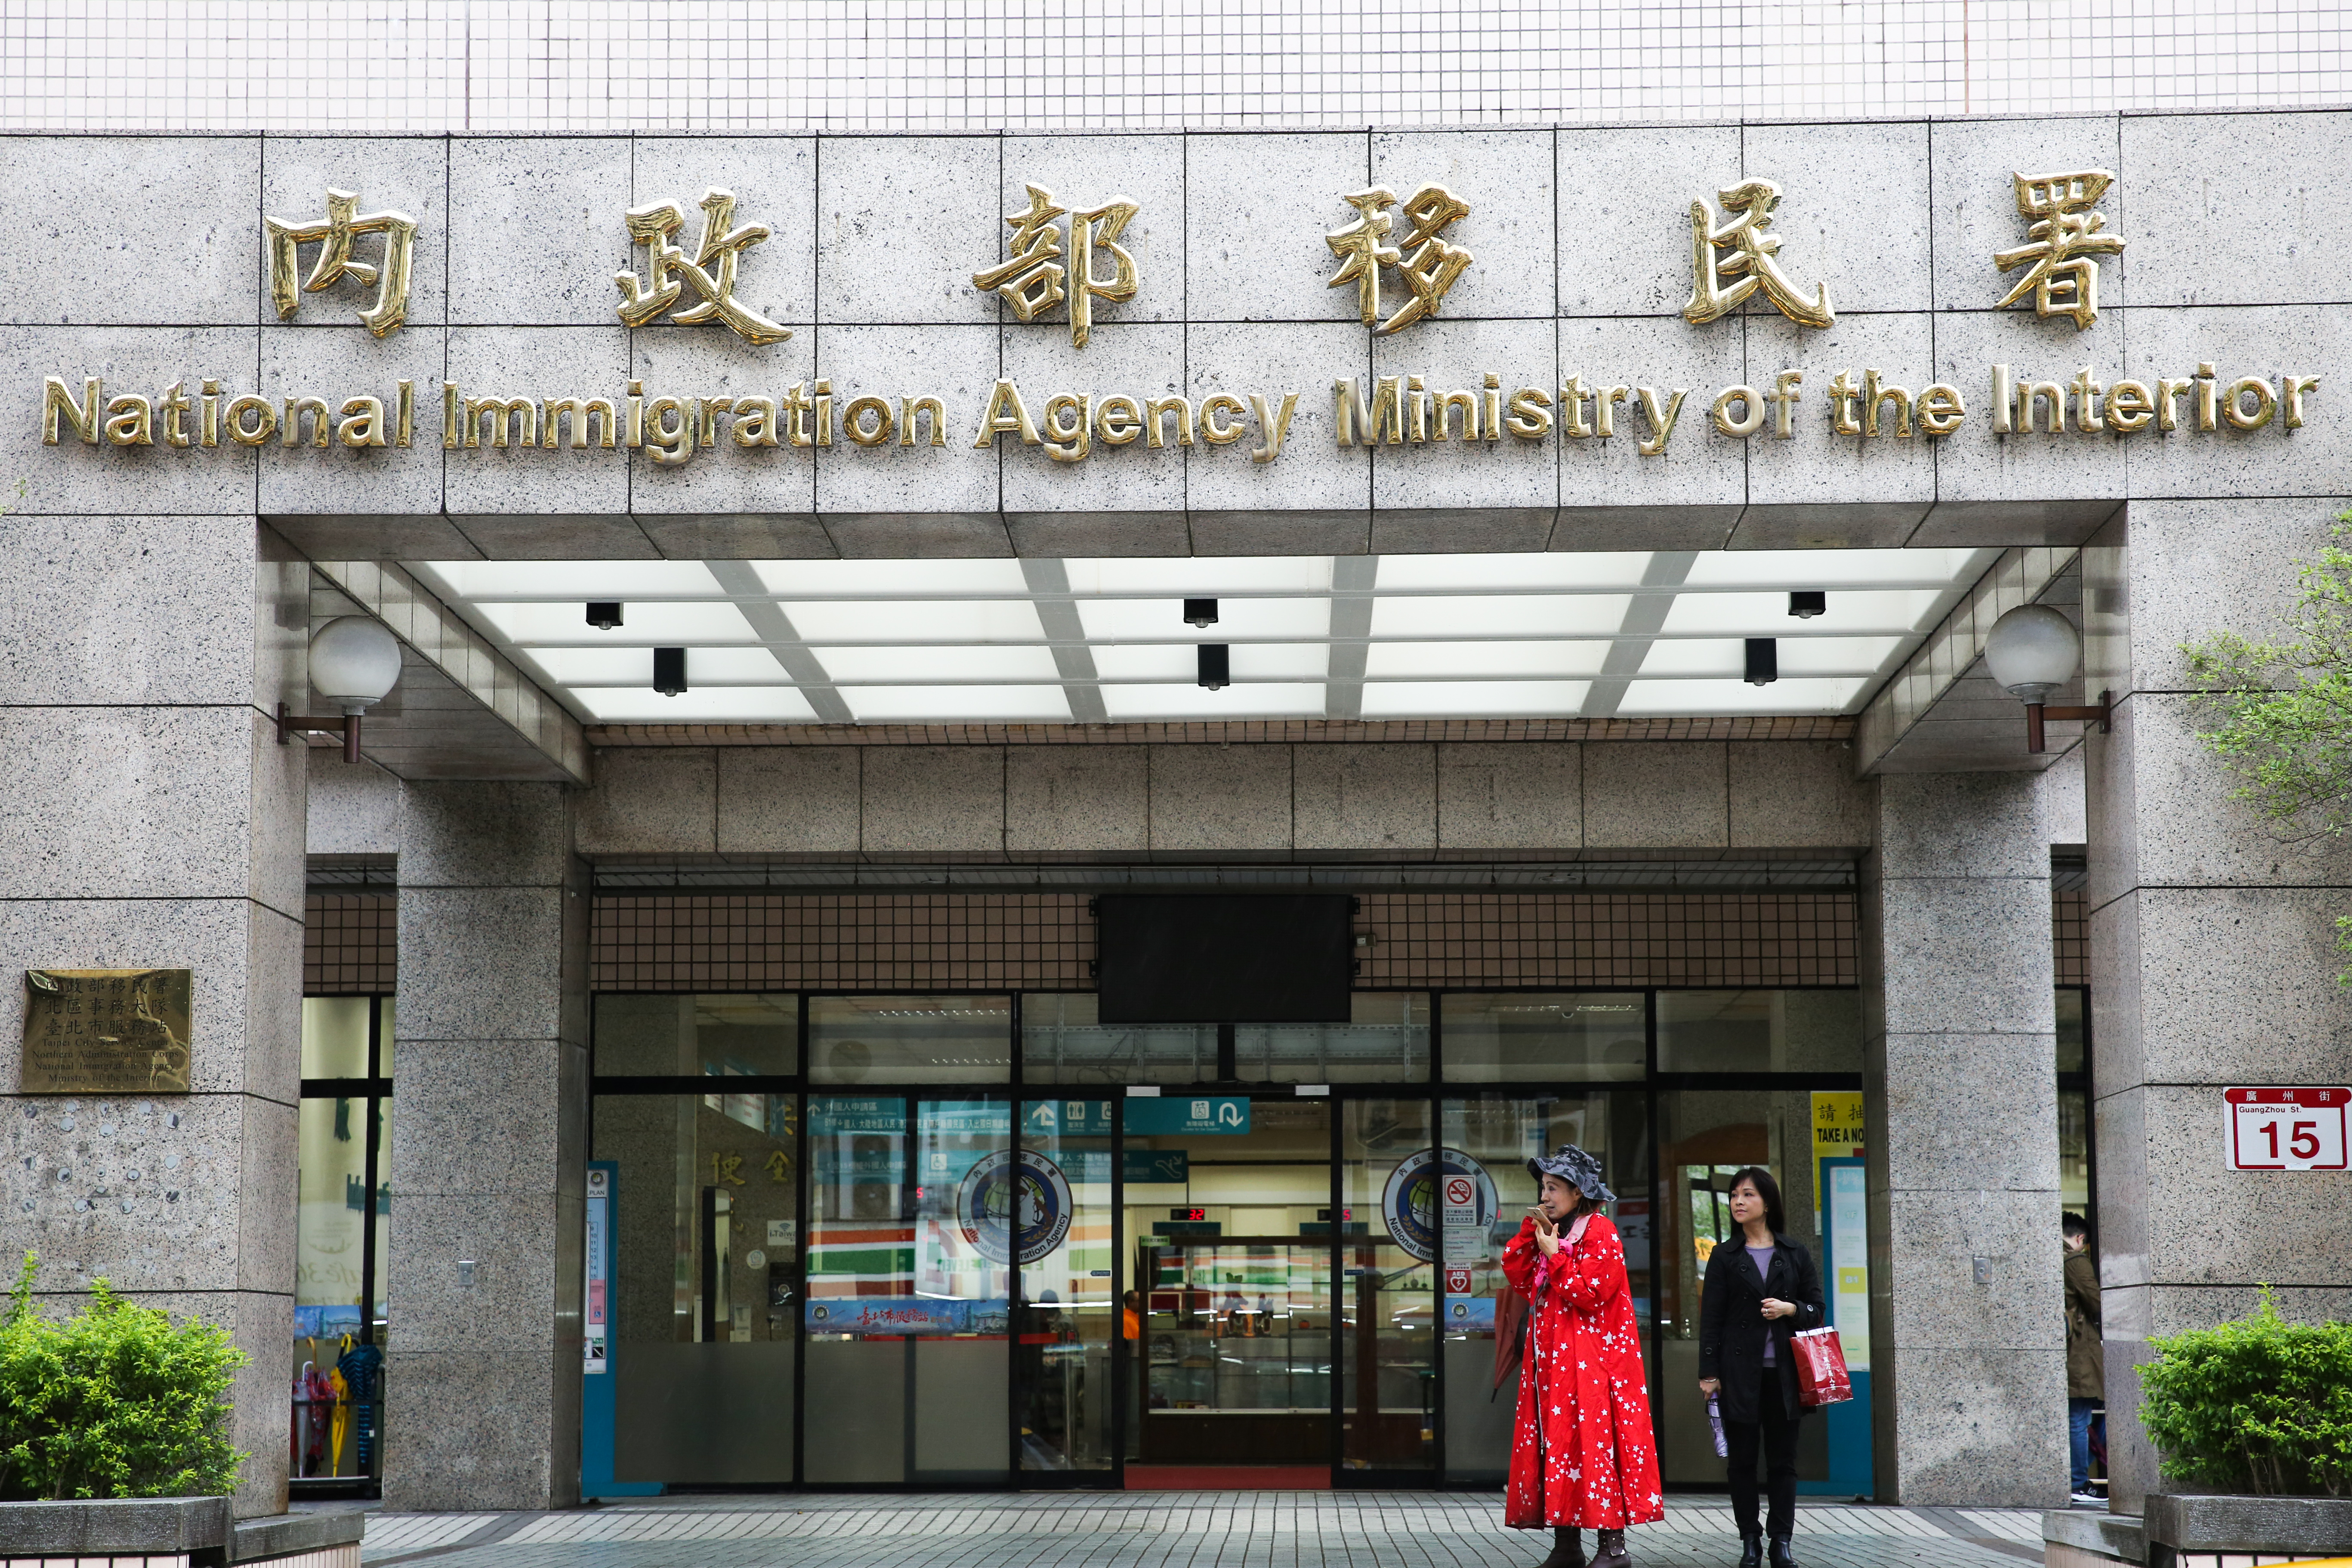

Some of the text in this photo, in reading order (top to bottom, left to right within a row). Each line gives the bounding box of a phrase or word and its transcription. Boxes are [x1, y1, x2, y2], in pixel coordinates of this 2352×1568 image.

[41, 360, 2324, 466] National Immigration Agency Ministry of the Interior
[44, 997, 168, 1015] 北區事務大隊
[45, 1018, 168, 1037] 臺北市服務站
[42, 1037, 169, 1049] Taipei City Service Center
[33, 1049, 179, 1060] Northern Administration Corps
[35, 1061, 175, 1072] National Immigration Agency
[48, 1074, 87, 1083] Ministry
[93, 1074, 103, 1082] of
[126, 1074, 161, 1082] Interior
[2246, 1091, 2330, 1102] 廣州街
[1817, 1104, 1864, 1122] 請抽
[1817, 1128, 1864, 1143] TAKE A NO
[2259, 1120, 2321, 1159] 15
[1188, 1209, 1205, 1220] 32
[1845, 1210, 1857, 1219] 1F
[963, 1218, 991, 1253] National
[1046, 1212, 1068, 1246] Agency
[1389, 1217, 1417, 1251] National
[1846, 1275, 1859, 1284] B1
